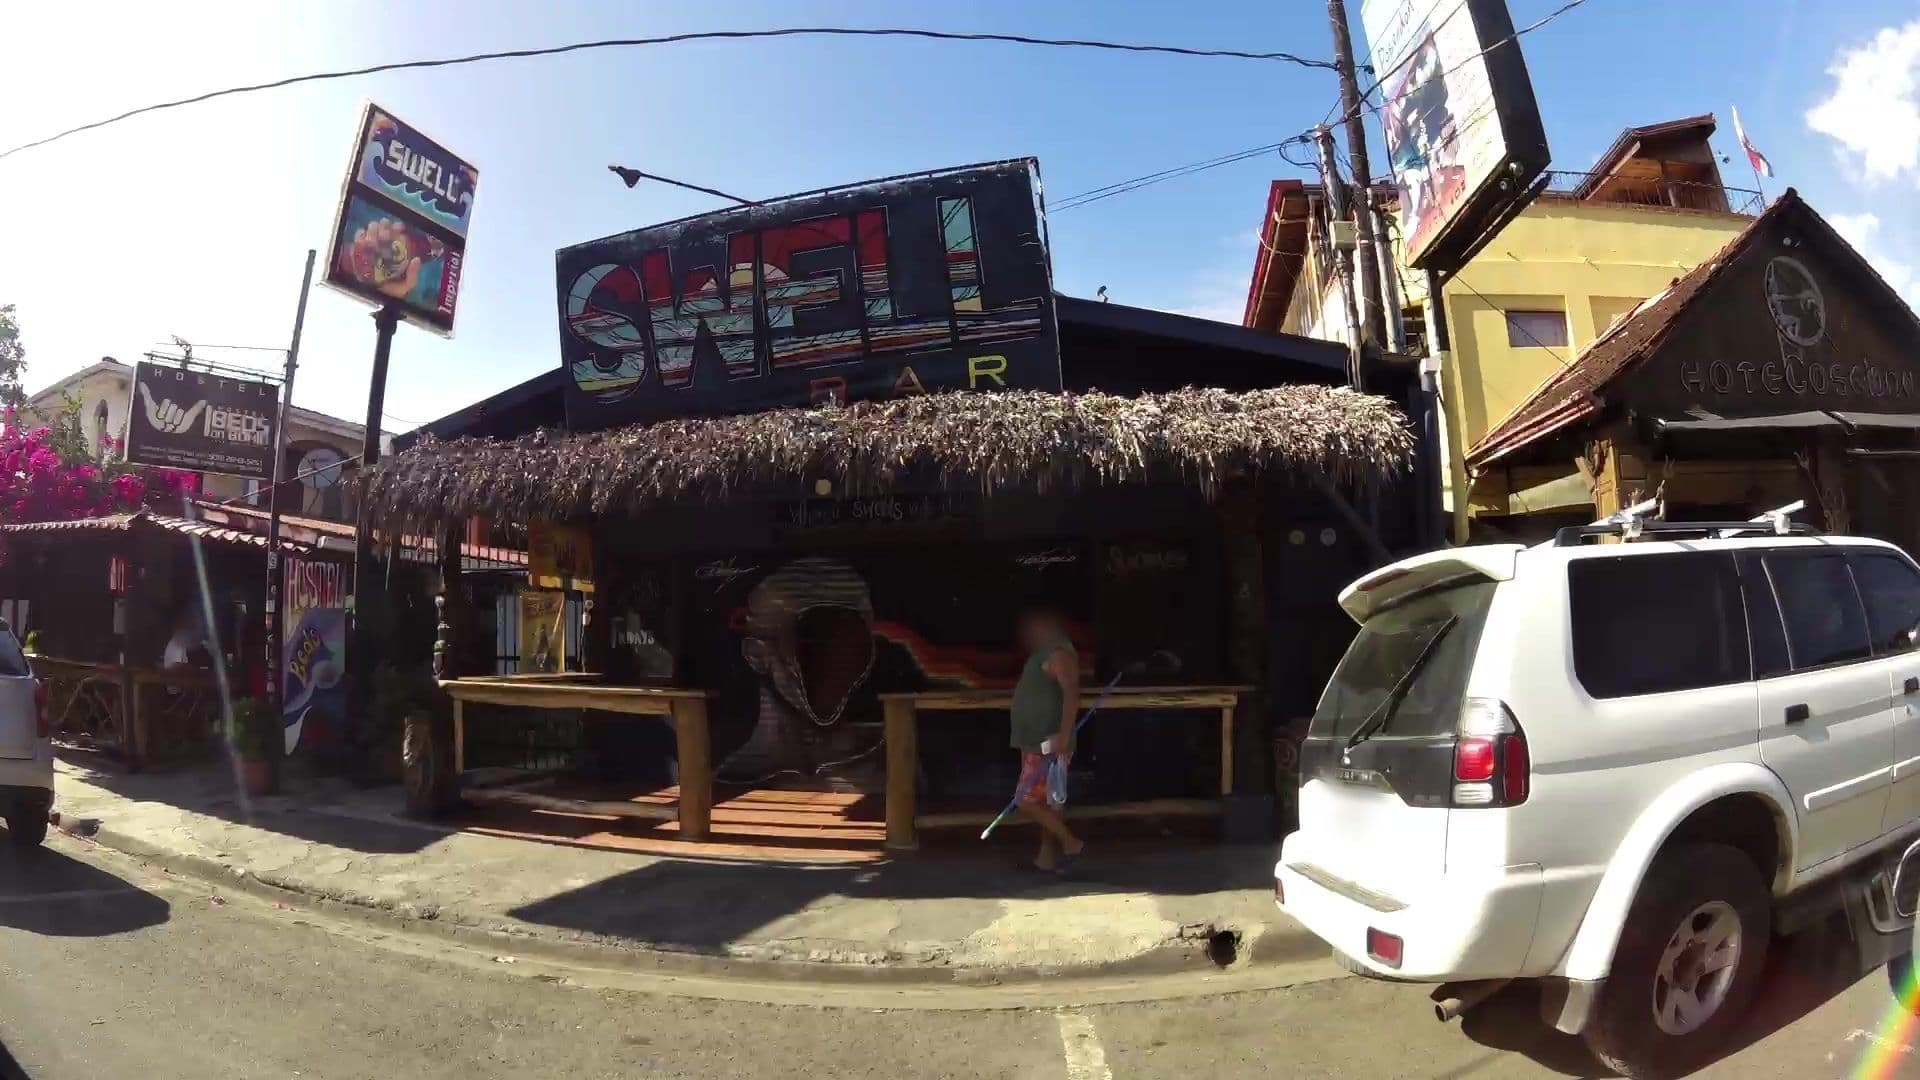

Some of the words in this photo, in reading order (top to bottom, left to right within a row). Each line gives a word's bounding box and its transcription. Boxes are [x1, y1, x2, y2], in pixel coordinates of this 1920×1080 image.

[386, 139, 457, 203] SWELL
[566, 195, 1044, 405] SWELL
[153, 367, 267, 397] HOSTEL
[287, 557, 344, 609] HOSTEL
